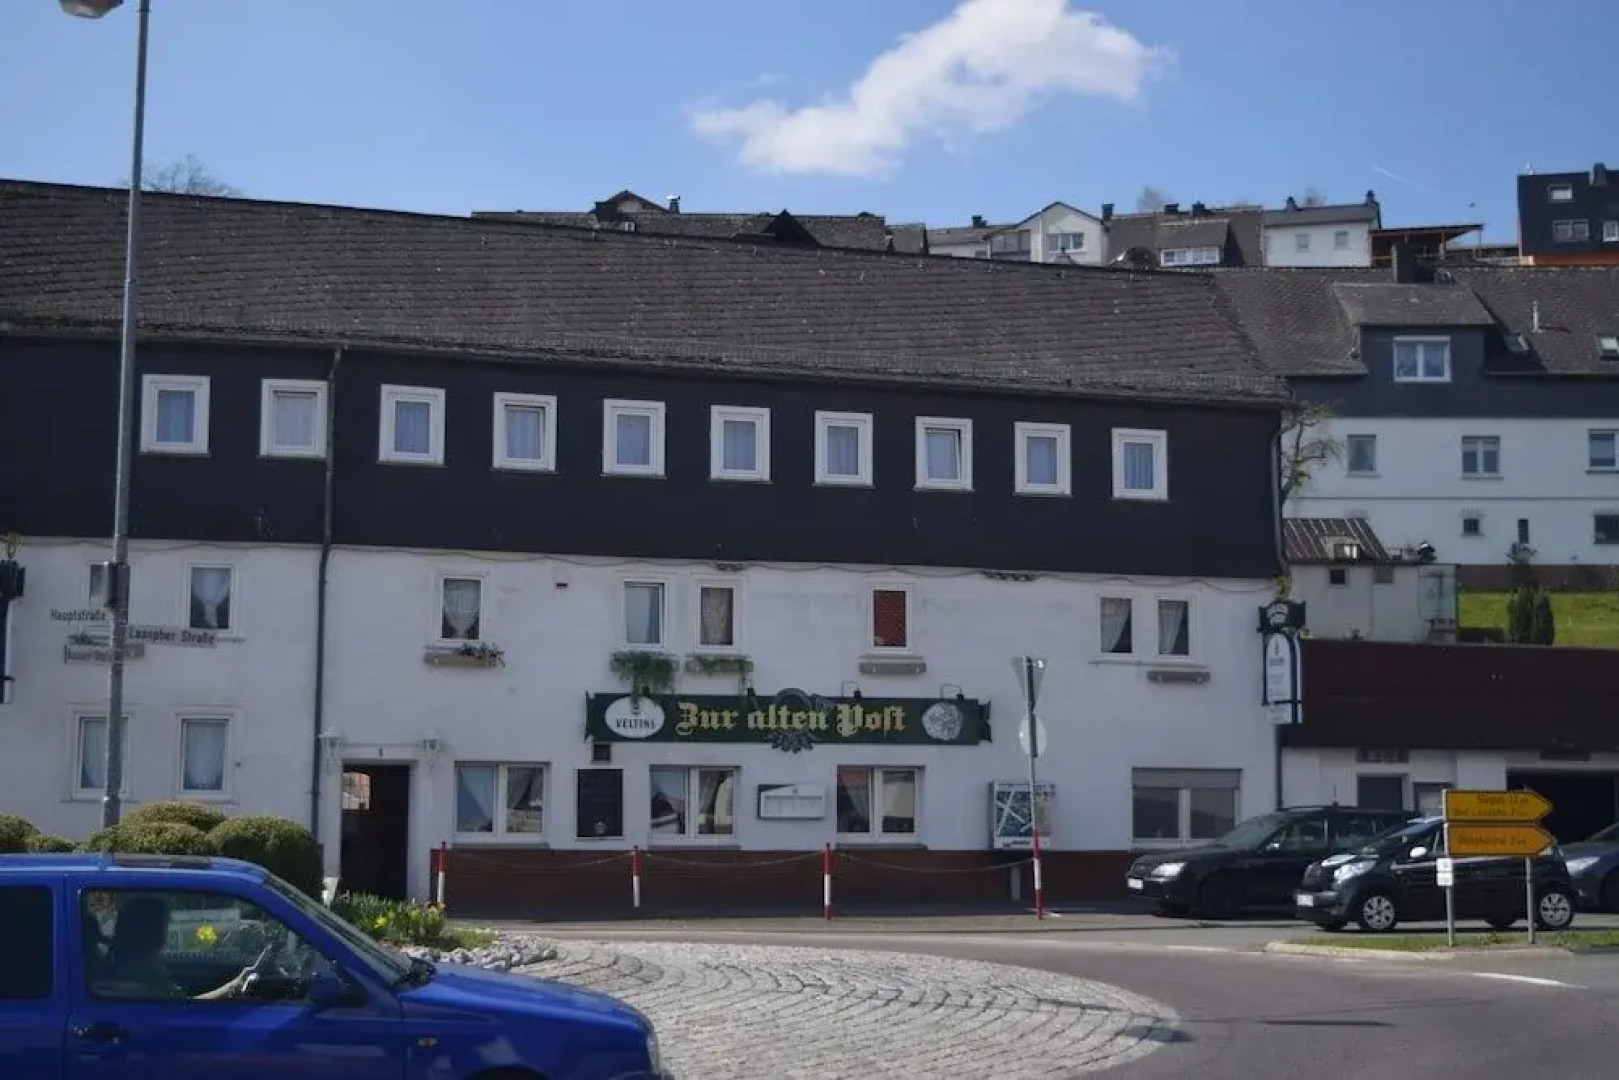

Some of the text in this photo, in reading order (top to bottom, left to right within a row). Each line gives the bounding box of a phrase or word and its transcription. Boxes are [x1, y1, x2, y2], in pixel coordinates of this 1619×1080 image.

[181, 630, 215, 645] Straße
[615, 718, 655, 730] VELTINS
[675, 702, 739, 736] Zur
[747, 704, 828, 730] alten
